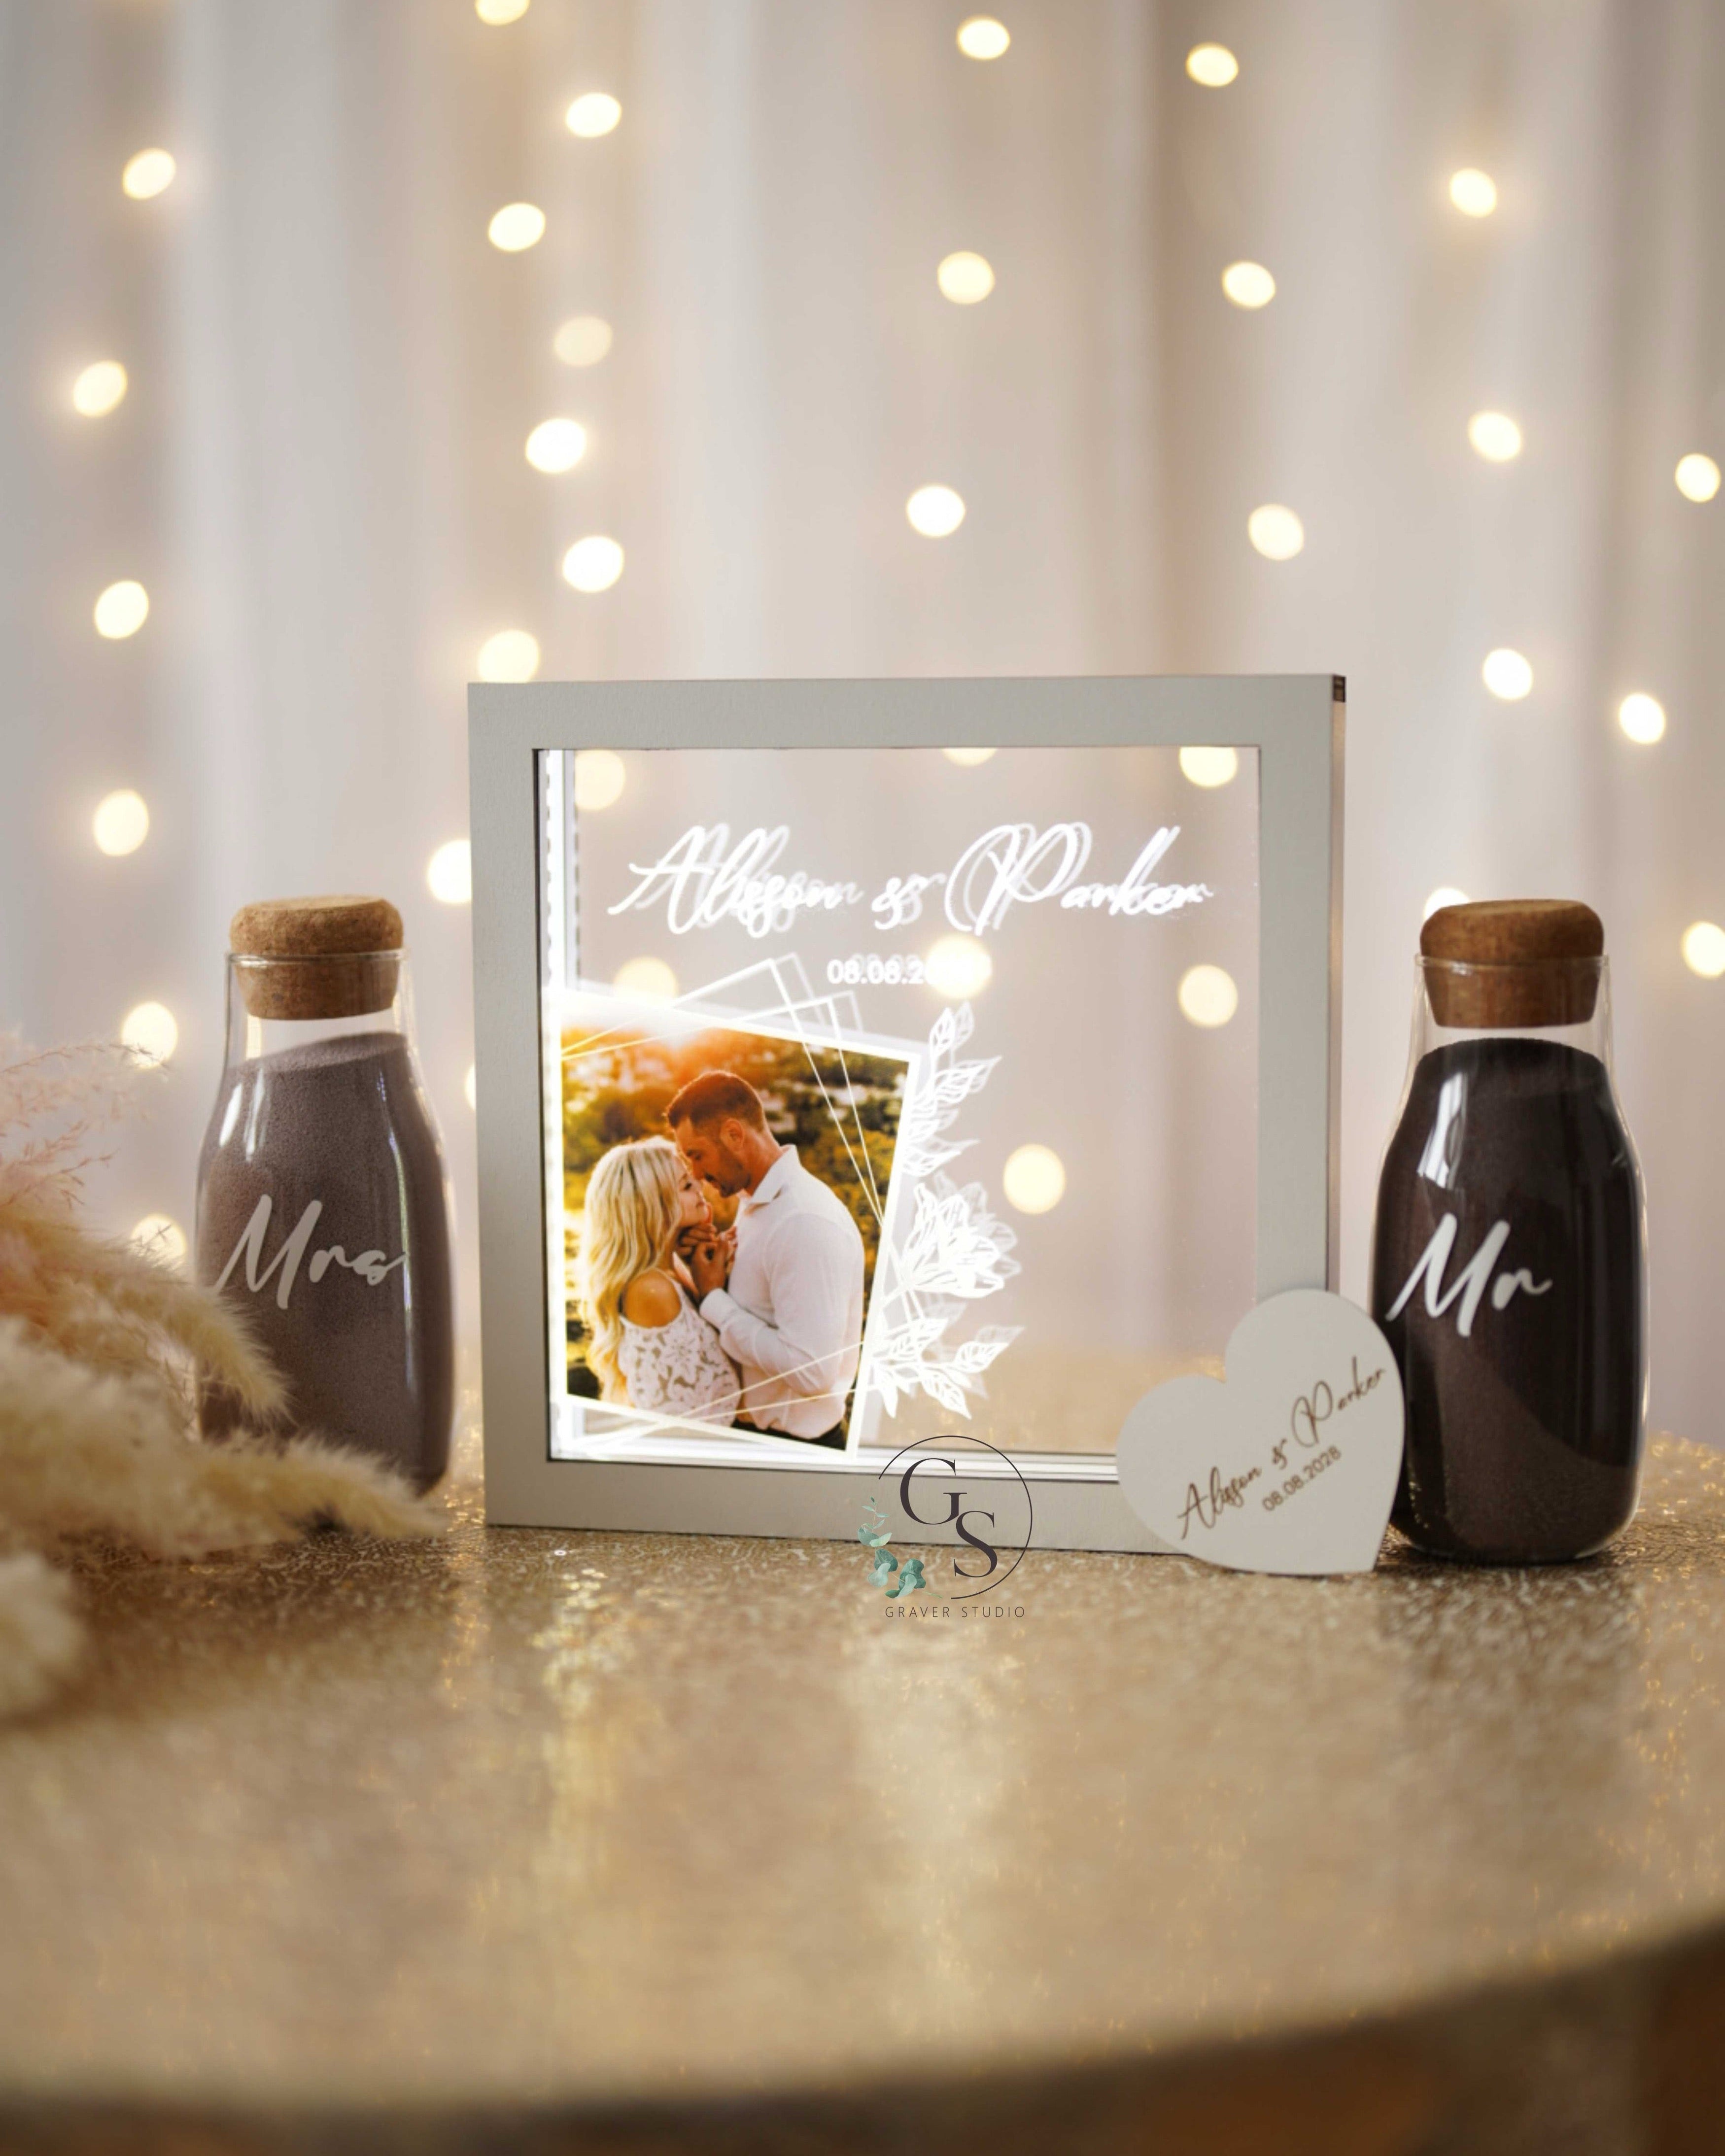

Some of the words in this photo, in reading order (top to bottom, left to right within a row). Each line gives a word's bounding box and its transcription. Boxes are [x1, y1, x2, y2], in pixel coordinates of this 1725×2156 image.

[944, 822, 1208, 936] Parker
[827, 957, 974, 985] 08.08.2
[213, 1194, 408, 1310] Mrs
[1385, 1212, 1553, 1337] Mr
[1272, 1438, 1288, 1470] &
[1291, 1355, 1386, 1448] Parker
[1262, 1445, 1342, 1511] 08.08.2028
